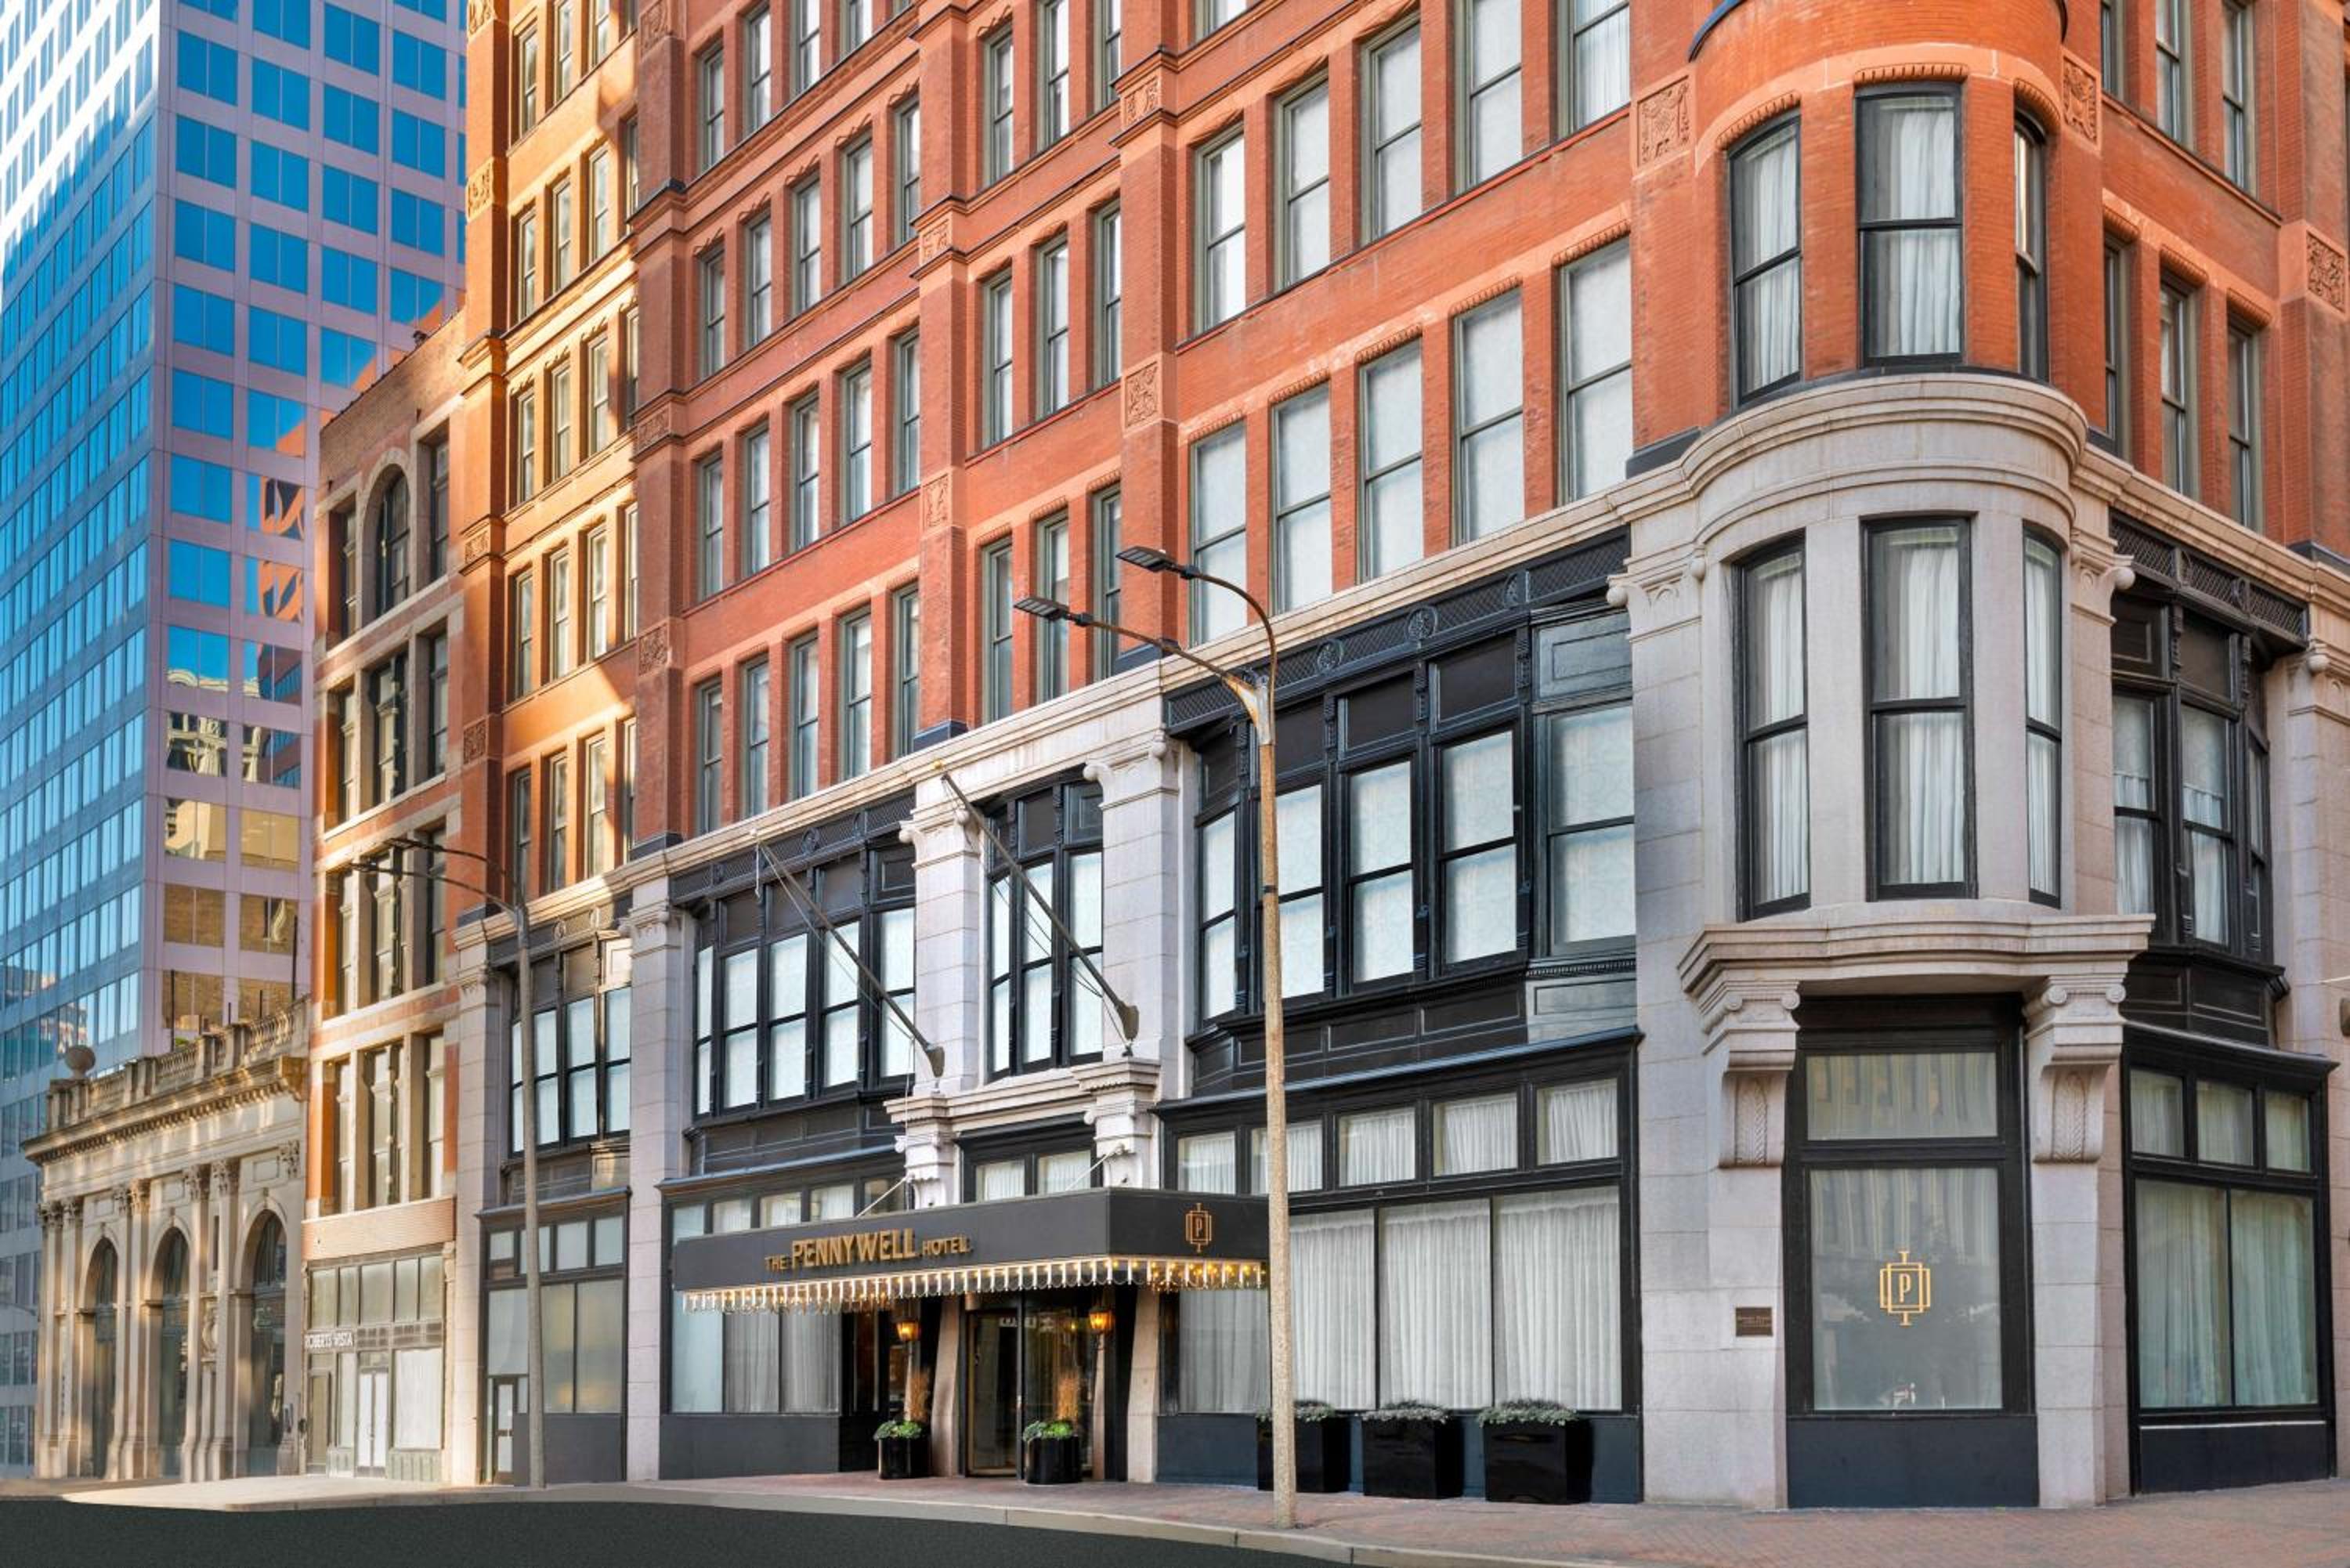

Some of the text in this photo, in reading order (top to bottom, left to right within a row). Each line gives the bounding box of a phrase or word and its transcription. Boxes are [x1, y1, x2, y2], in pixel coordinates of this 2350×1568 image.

[765, 1228, 971, 1272] THE PENNYWELL HOTEL
[1899, 1273, 1911, 1303] P
